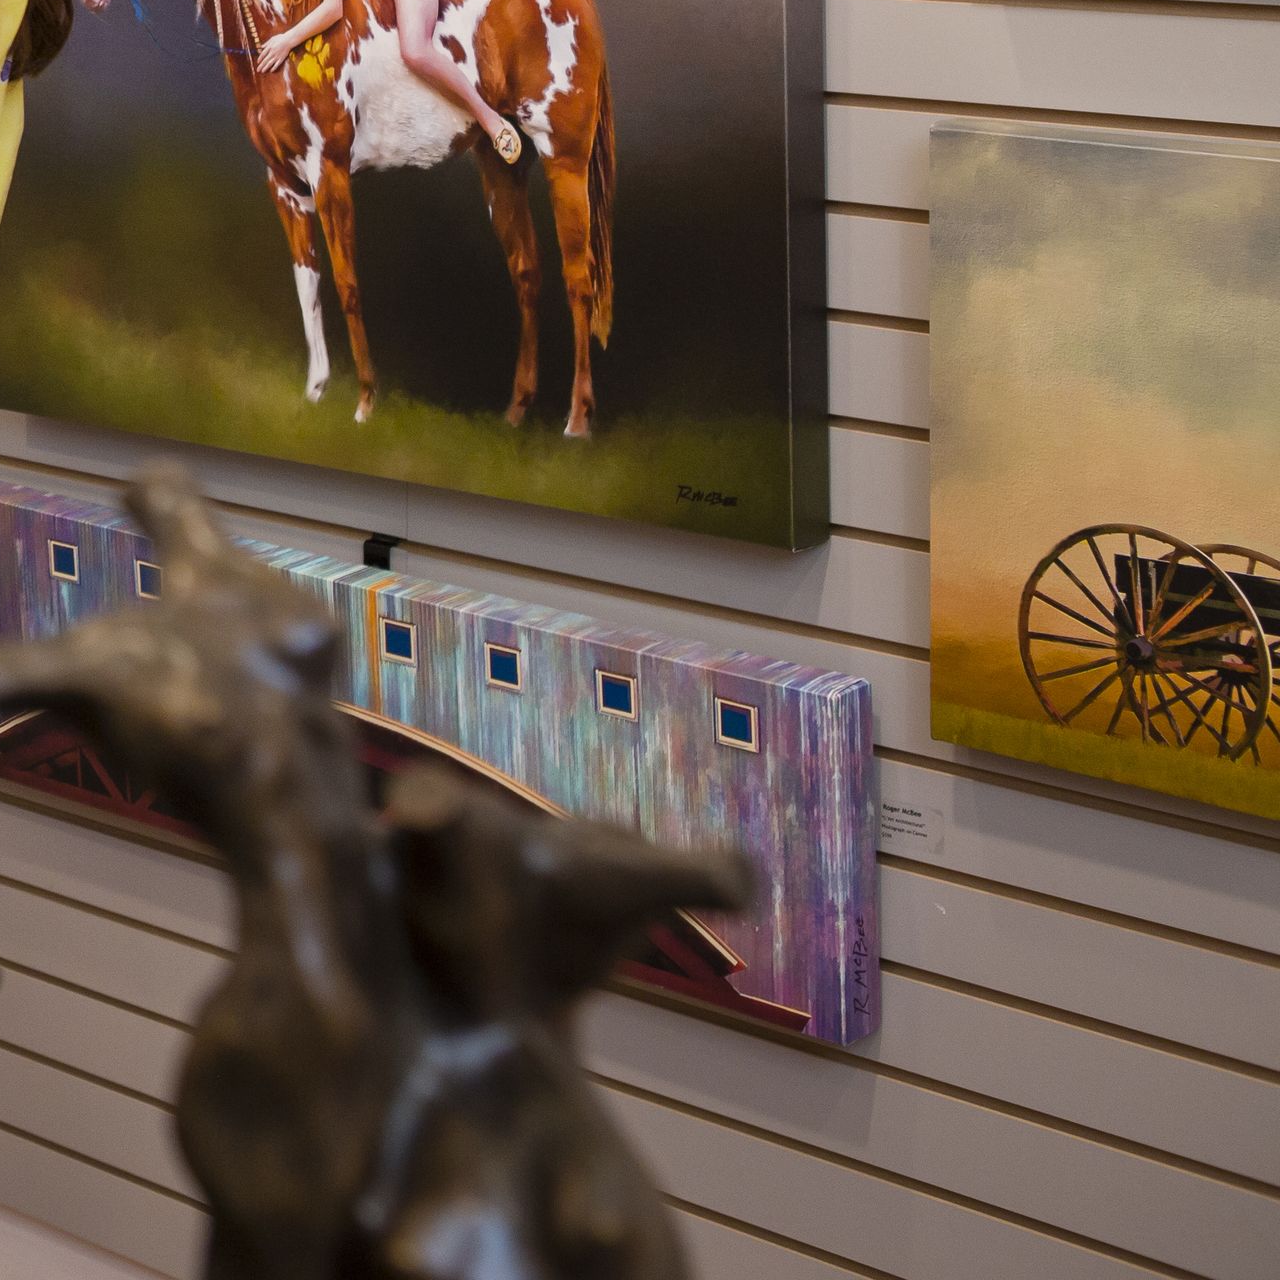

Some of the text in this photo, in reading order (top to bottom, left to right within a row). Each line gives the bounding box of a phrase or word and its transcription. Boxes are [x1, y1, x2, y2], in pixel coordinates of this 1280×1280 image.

[882, 804, 922, 817] Roger McBee
[853, 992, 872, 1016] R
